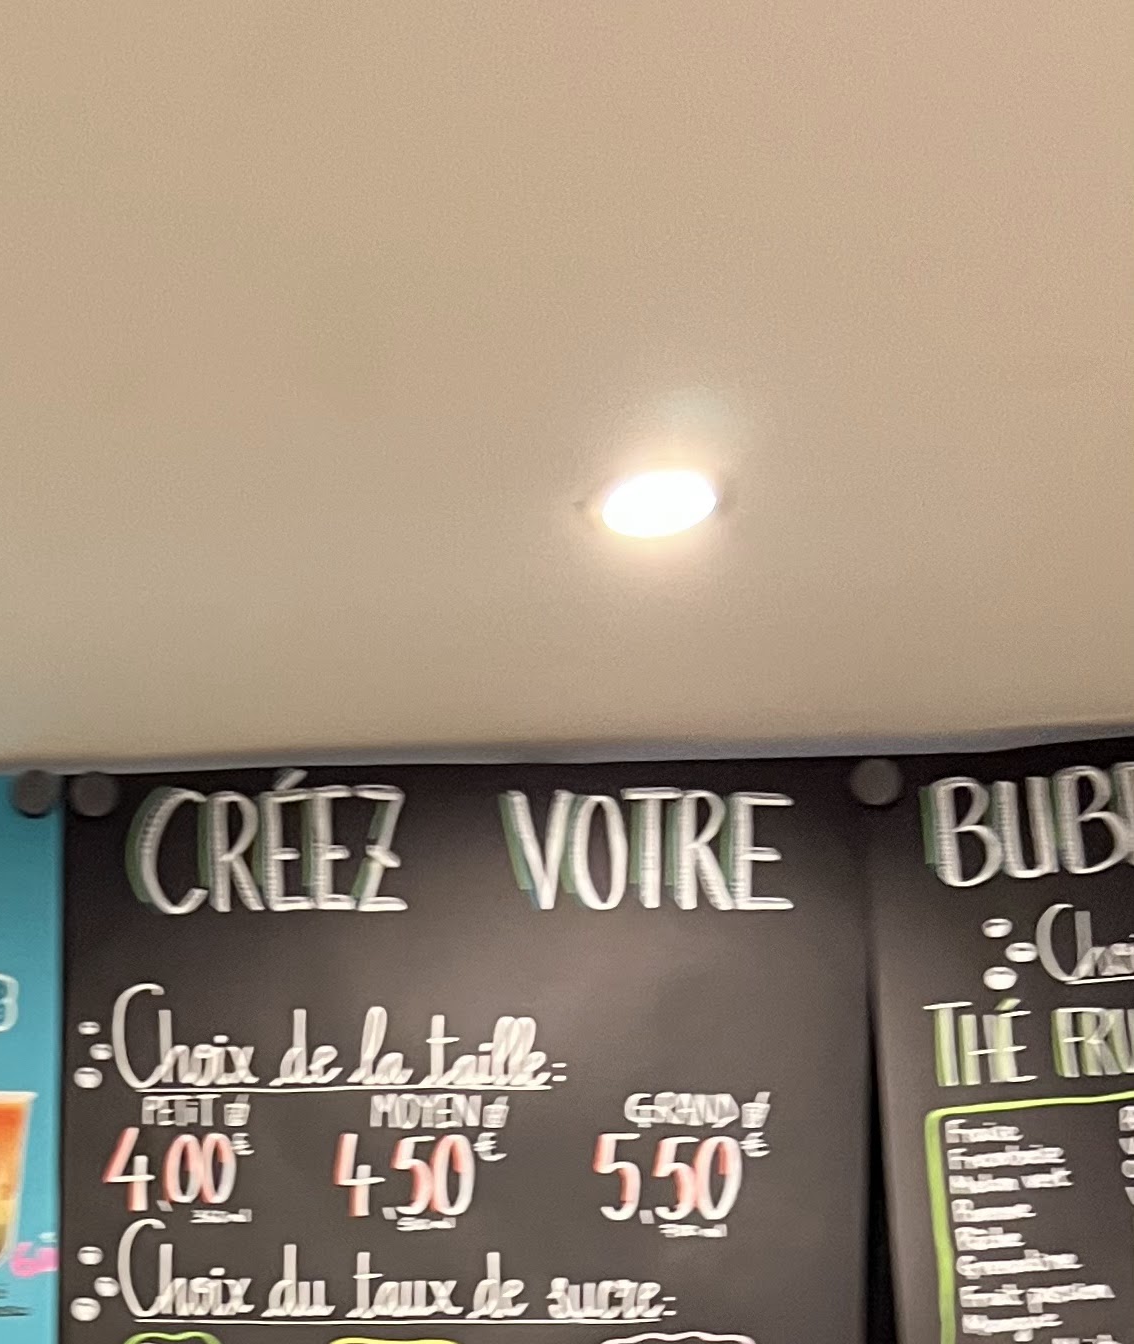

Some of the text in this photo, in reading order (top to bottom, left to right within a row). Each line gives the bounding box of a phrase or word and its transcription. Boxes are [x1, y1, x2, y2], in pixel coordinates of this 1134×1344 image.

[124, 769, 795, 914] CRÉEZ VOTRE
[112, 982, 260, 1091] Choix
[268, 1009, 341, 1086] de
[348, 1006, 413, 1085] la
[923, 998, 1038, 1086] THÉ
[141, 1092, 739, 1129] PETIT MOYEN GRAND
[118, 1218, 254, 1320] Choix
[262, 1244, 333, 1318] du
[346, 1252, 463, 1318] taux
[465, 1252, 528, 1318] de
